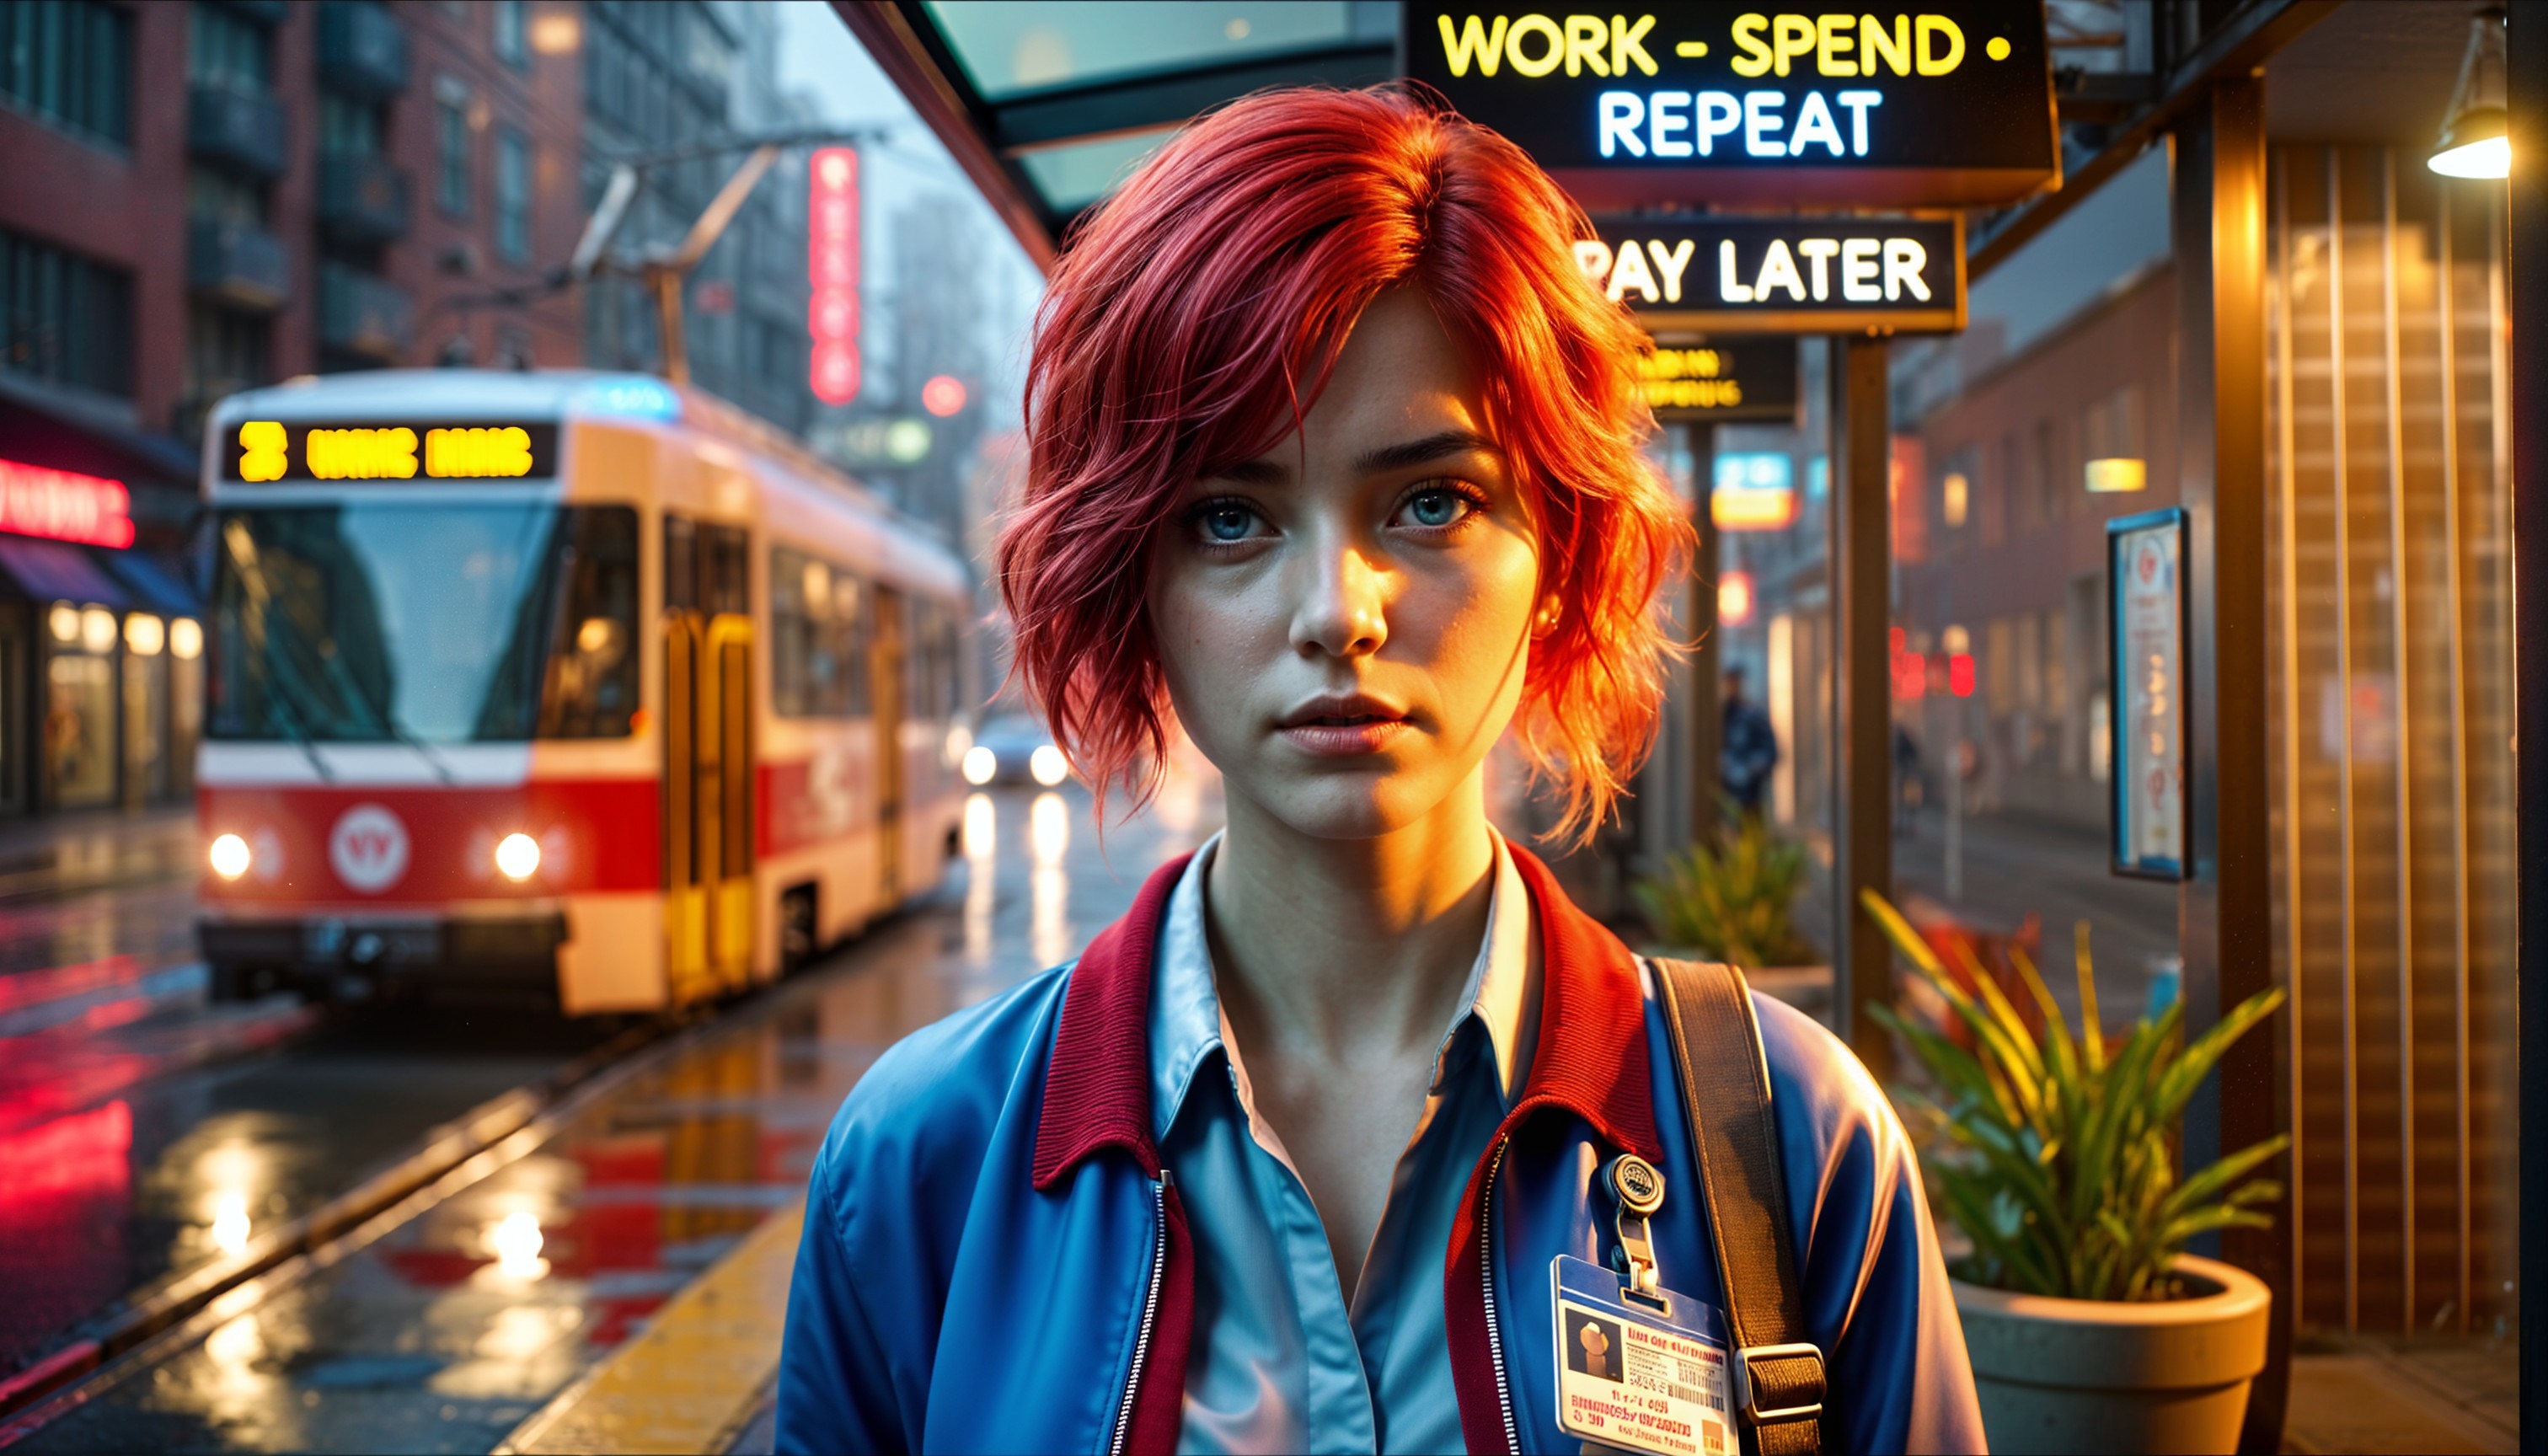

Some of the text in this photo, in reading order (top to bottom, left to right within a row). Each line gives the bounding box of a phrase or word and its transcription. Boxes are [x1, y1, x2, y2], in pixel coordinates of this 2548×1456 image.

[1437, 13, 1658, 78] WORK
[1731, 13, 1966, 78] SPEND
[1598, 90, 1883, 158] REPEAT
[1572, 238, 1931, 302] PAY LATER
